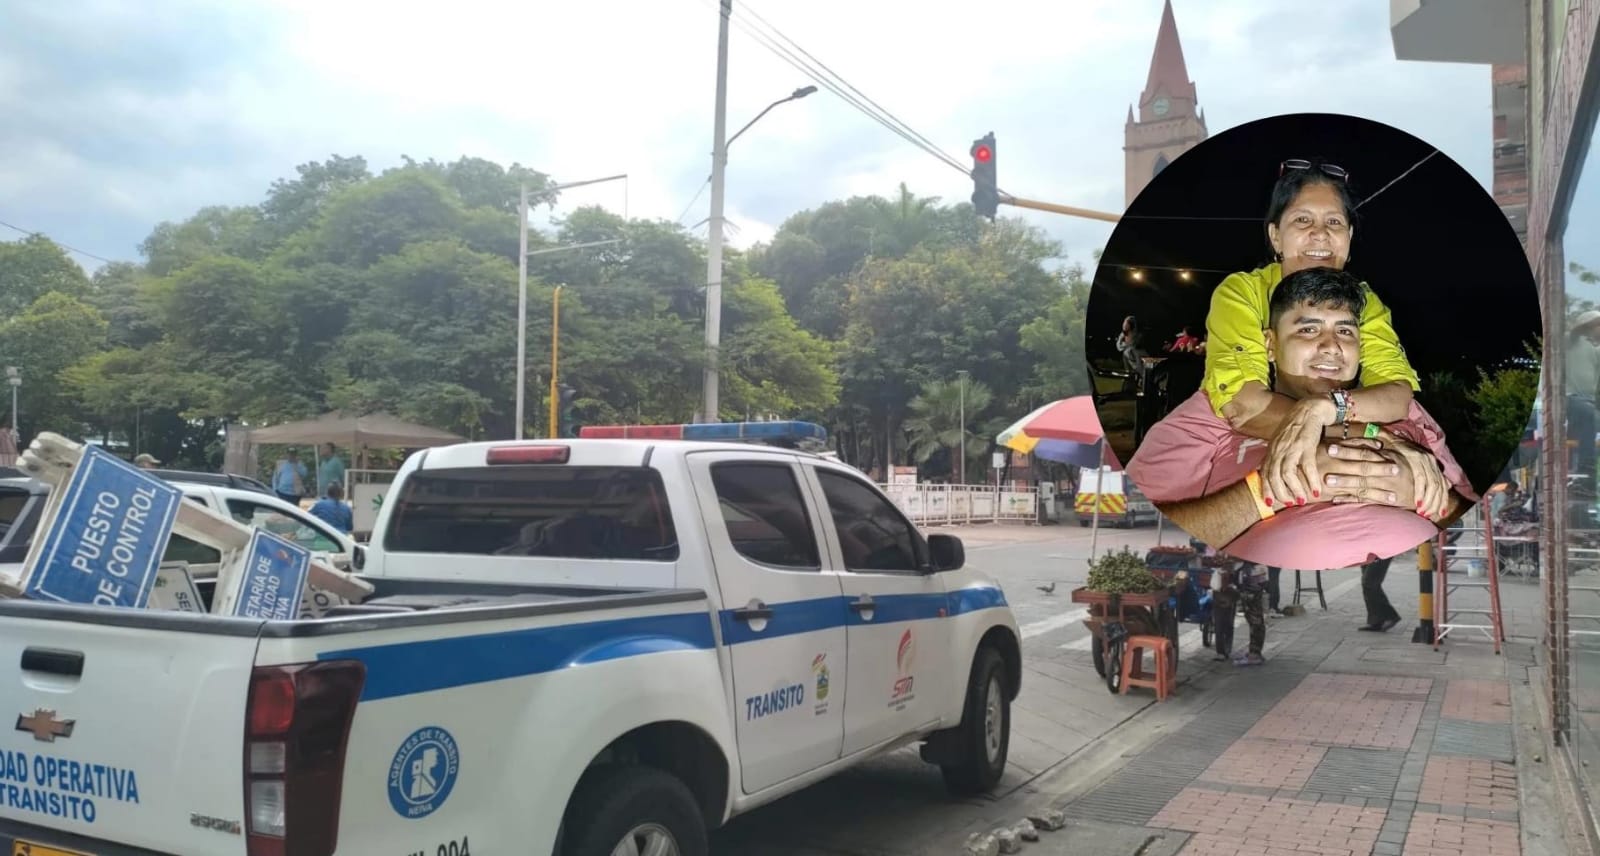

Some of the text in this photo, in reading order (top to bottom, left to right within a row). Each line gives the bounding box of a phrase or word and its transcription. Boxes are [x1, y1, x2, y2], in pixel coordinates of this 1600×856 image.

[71, 491, 120, 574] PUESTO
[93, 487, 156, 606] DE CONTROL
[257, 555, 272, 574] DE
[745, 683, 804, 721] TRANSITO
[34, 755, 140, 803] OPERATIVA
[390, 729, 458, 787] AGENTES DE TRANSITO
[0, 783, 96, 823] TRANSITO
[408, 803, 433, 817] NEIVA
